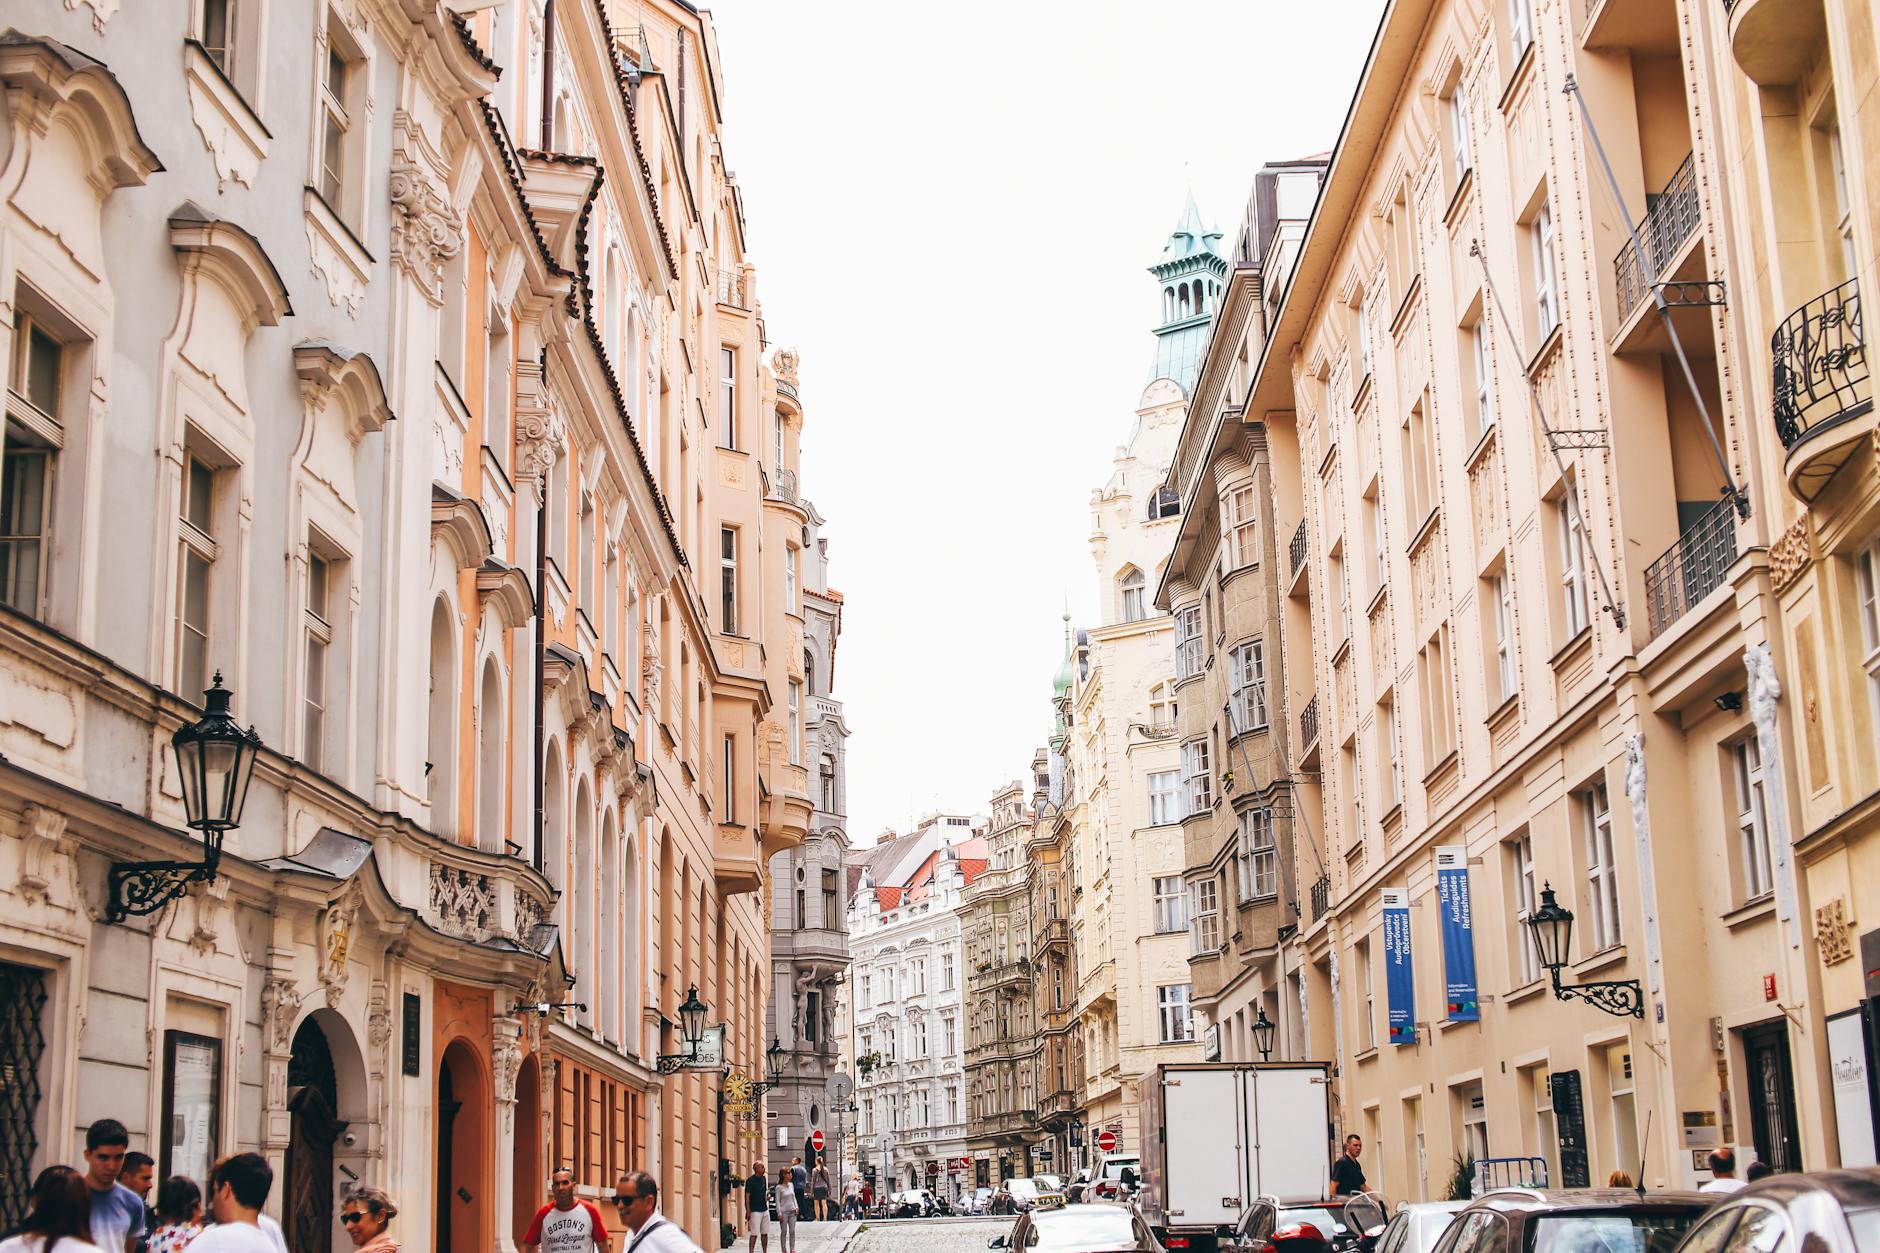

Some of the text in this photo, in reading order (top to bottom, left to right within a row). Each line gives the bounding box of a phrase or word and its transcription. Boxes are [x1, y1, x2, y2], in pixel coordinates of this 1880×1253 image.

[1441, 875, 1449, 904] Tickets
[1450, 875, 1460, 923] Audioguides
[1459, 875, 1470, 929] Refreshments
[1385, 913, 1393, 951] Vstupenky
[548, 1219, 585, 1235] BOSTON'S
